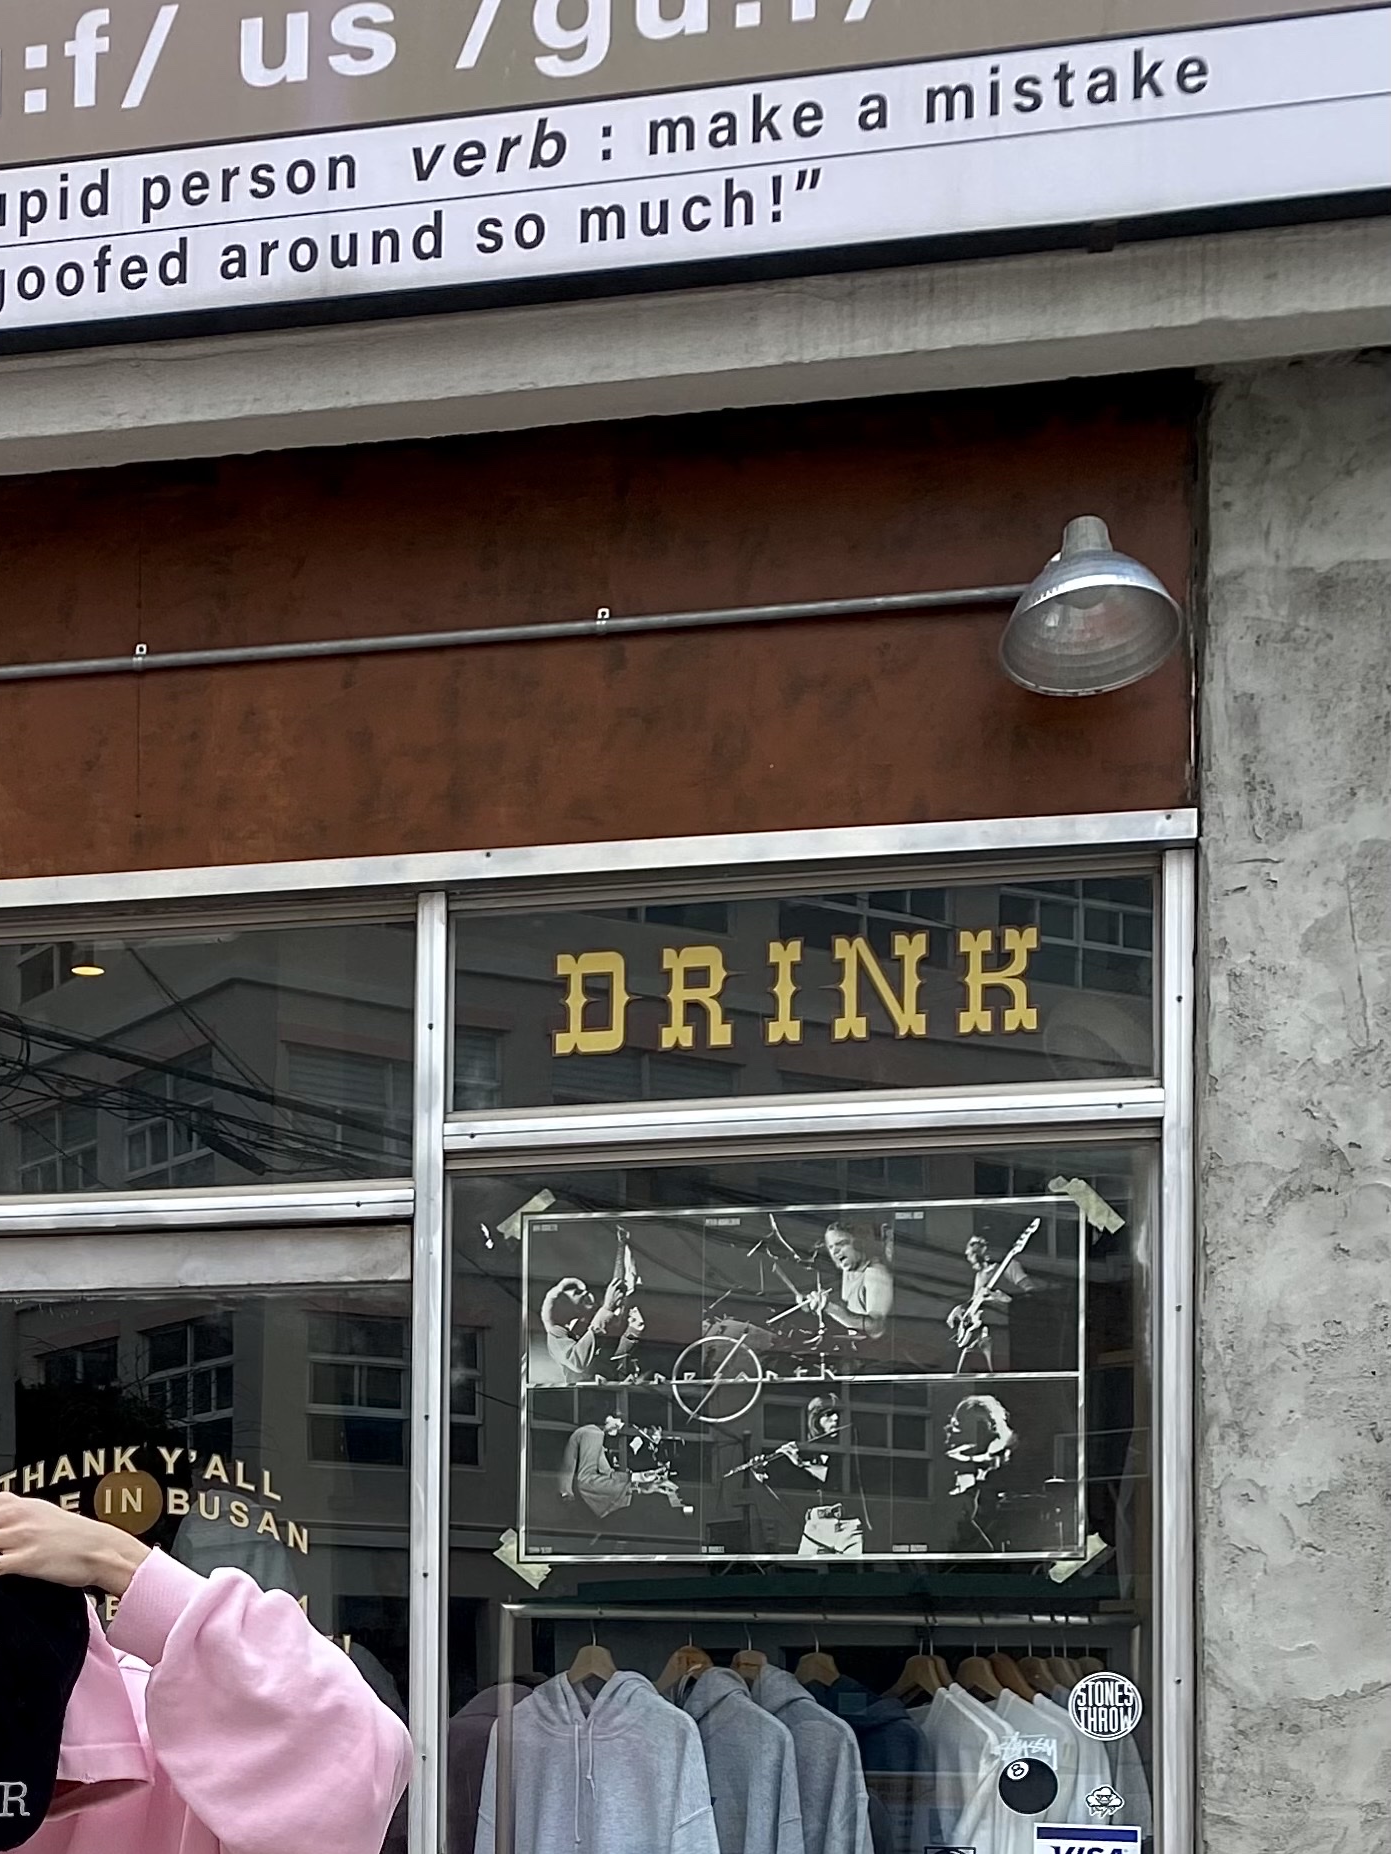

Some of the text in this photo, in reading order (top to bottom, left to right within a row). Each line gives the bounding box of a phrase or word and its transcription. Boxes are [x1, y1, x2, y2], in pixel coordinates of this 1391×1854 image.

[239, 0, 398, 87] us
[142, 154, 357, 225] person
[411, 117, 568, 183] verb
[648, 93, 824, 156] make
[858, 94, 887, 131] a
[925, 48, 1209, 124] mistake
[219, 209, 443, 280] around
[476, 213, 545, 255] so
[551, 925, 1039, 1057] DRINK
[156, 1445, 283, 1502] Y'ALL
[104, 1487, 144, 1514] IN
[166, 1488, 310, 1555] BUSAN
[1077, 1681, 1134, 1708] STONES
[1077, 1706, 1133, 1733] THROW
